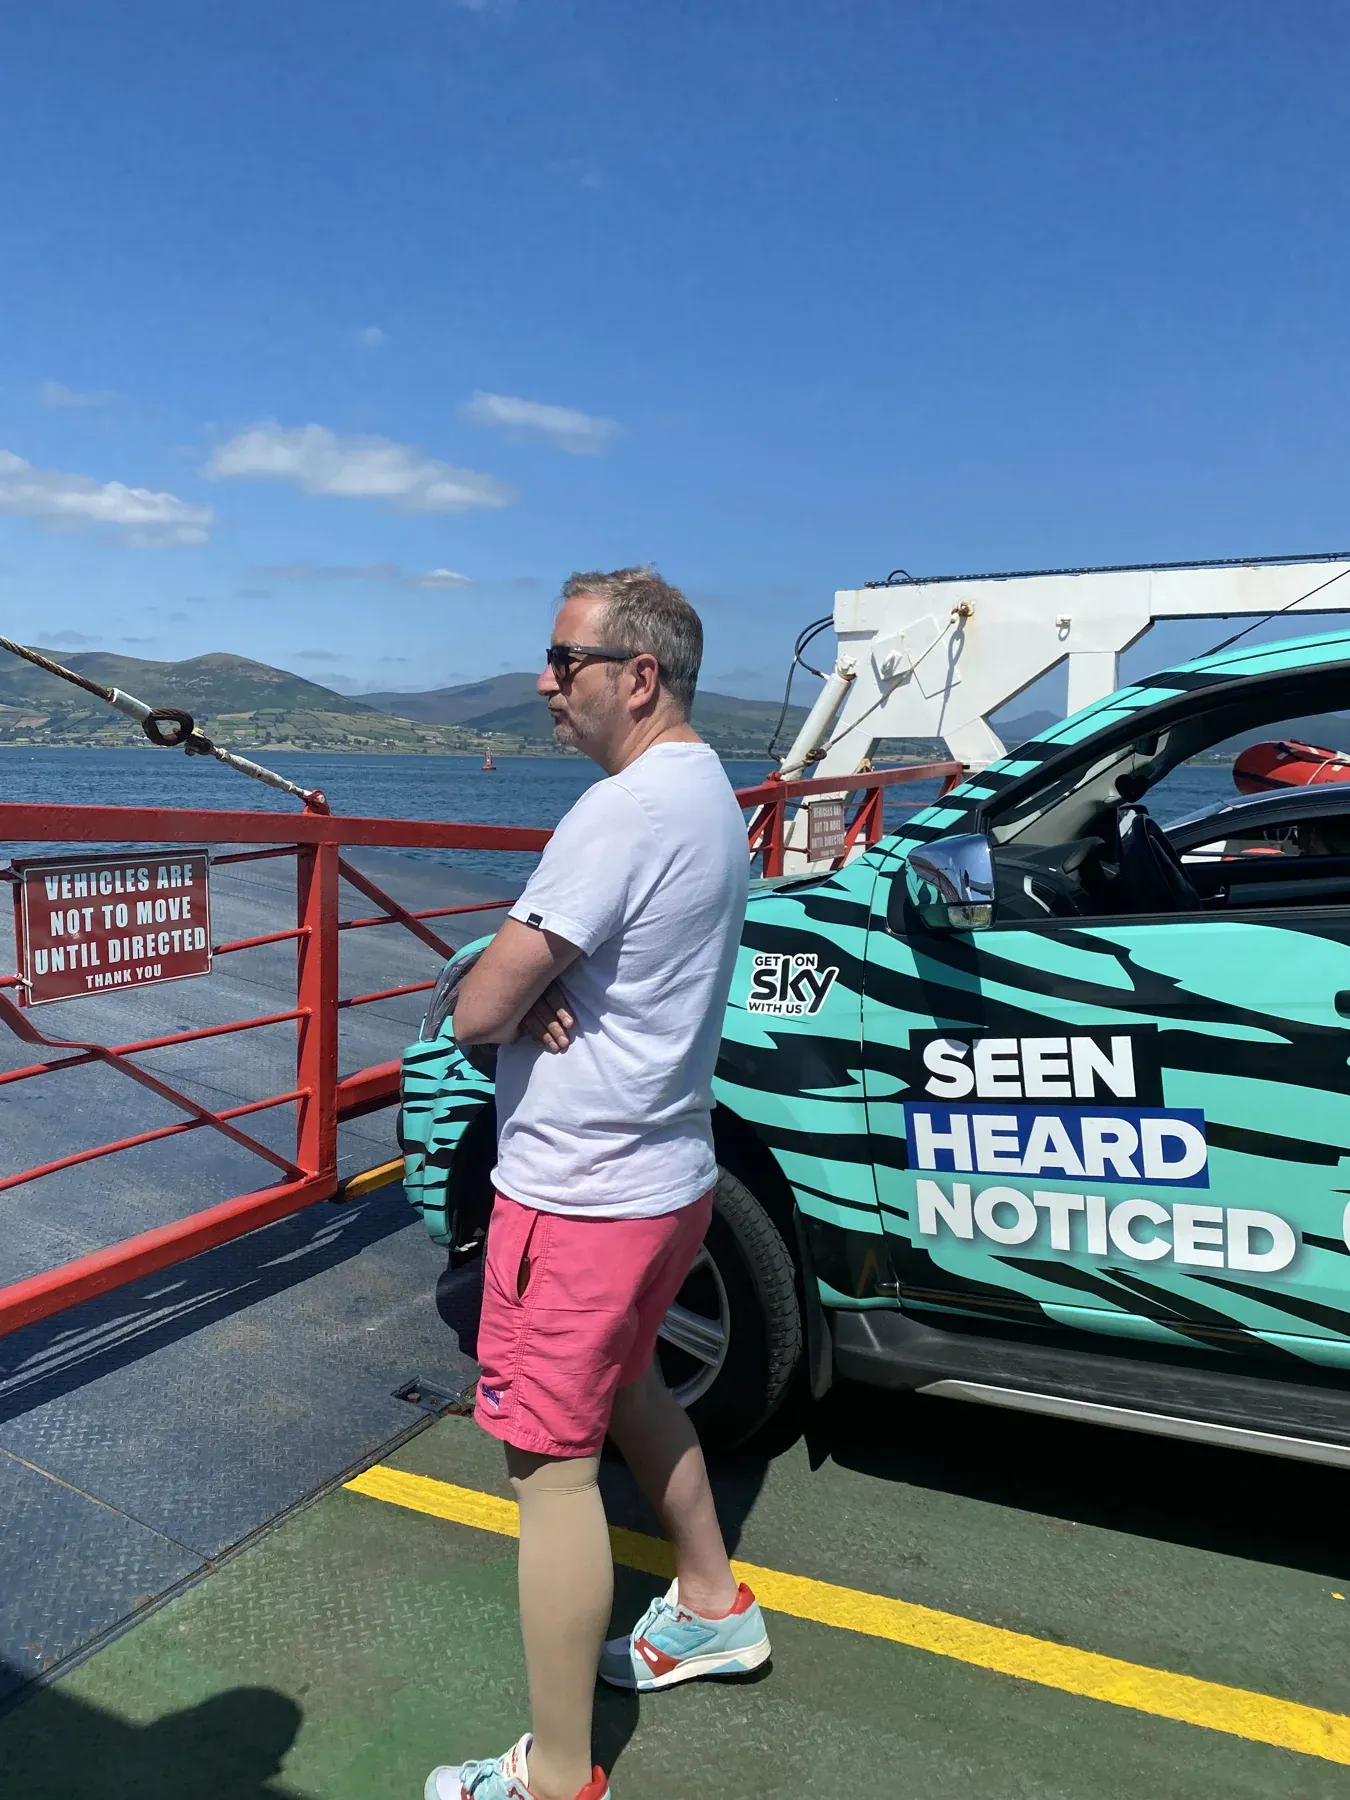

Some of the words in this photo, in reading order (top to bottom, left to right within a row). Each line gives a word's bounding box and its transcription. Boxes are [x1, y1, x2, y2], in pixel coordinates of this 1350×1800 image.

[44, 867, 149, 901] VEHICLES
[156, 863, 193, 889] ARE
[50, 907, 94, 937] NOT
[101, 903, 128, 930] TO
[136, 896, 191, 925] MOVE
[34, 942, 100, 975] UNTIL
[107, 927, 206, 964] DIRECTED
[754, 956, 780, 967] GET
[794, 956, 816, 967] ON
[85, 968, 132, 989] THANK
[136, 963, 162, 979] YOU
[748, 1001, 782, 1013] WITH
[785, 1004, 803, 1014] US
[922, 1035, 1137, 1099] SEEN
[912, 1112, 1207, 1180] HEARD
[916, 1178, 1296, 1273] NOTICED
